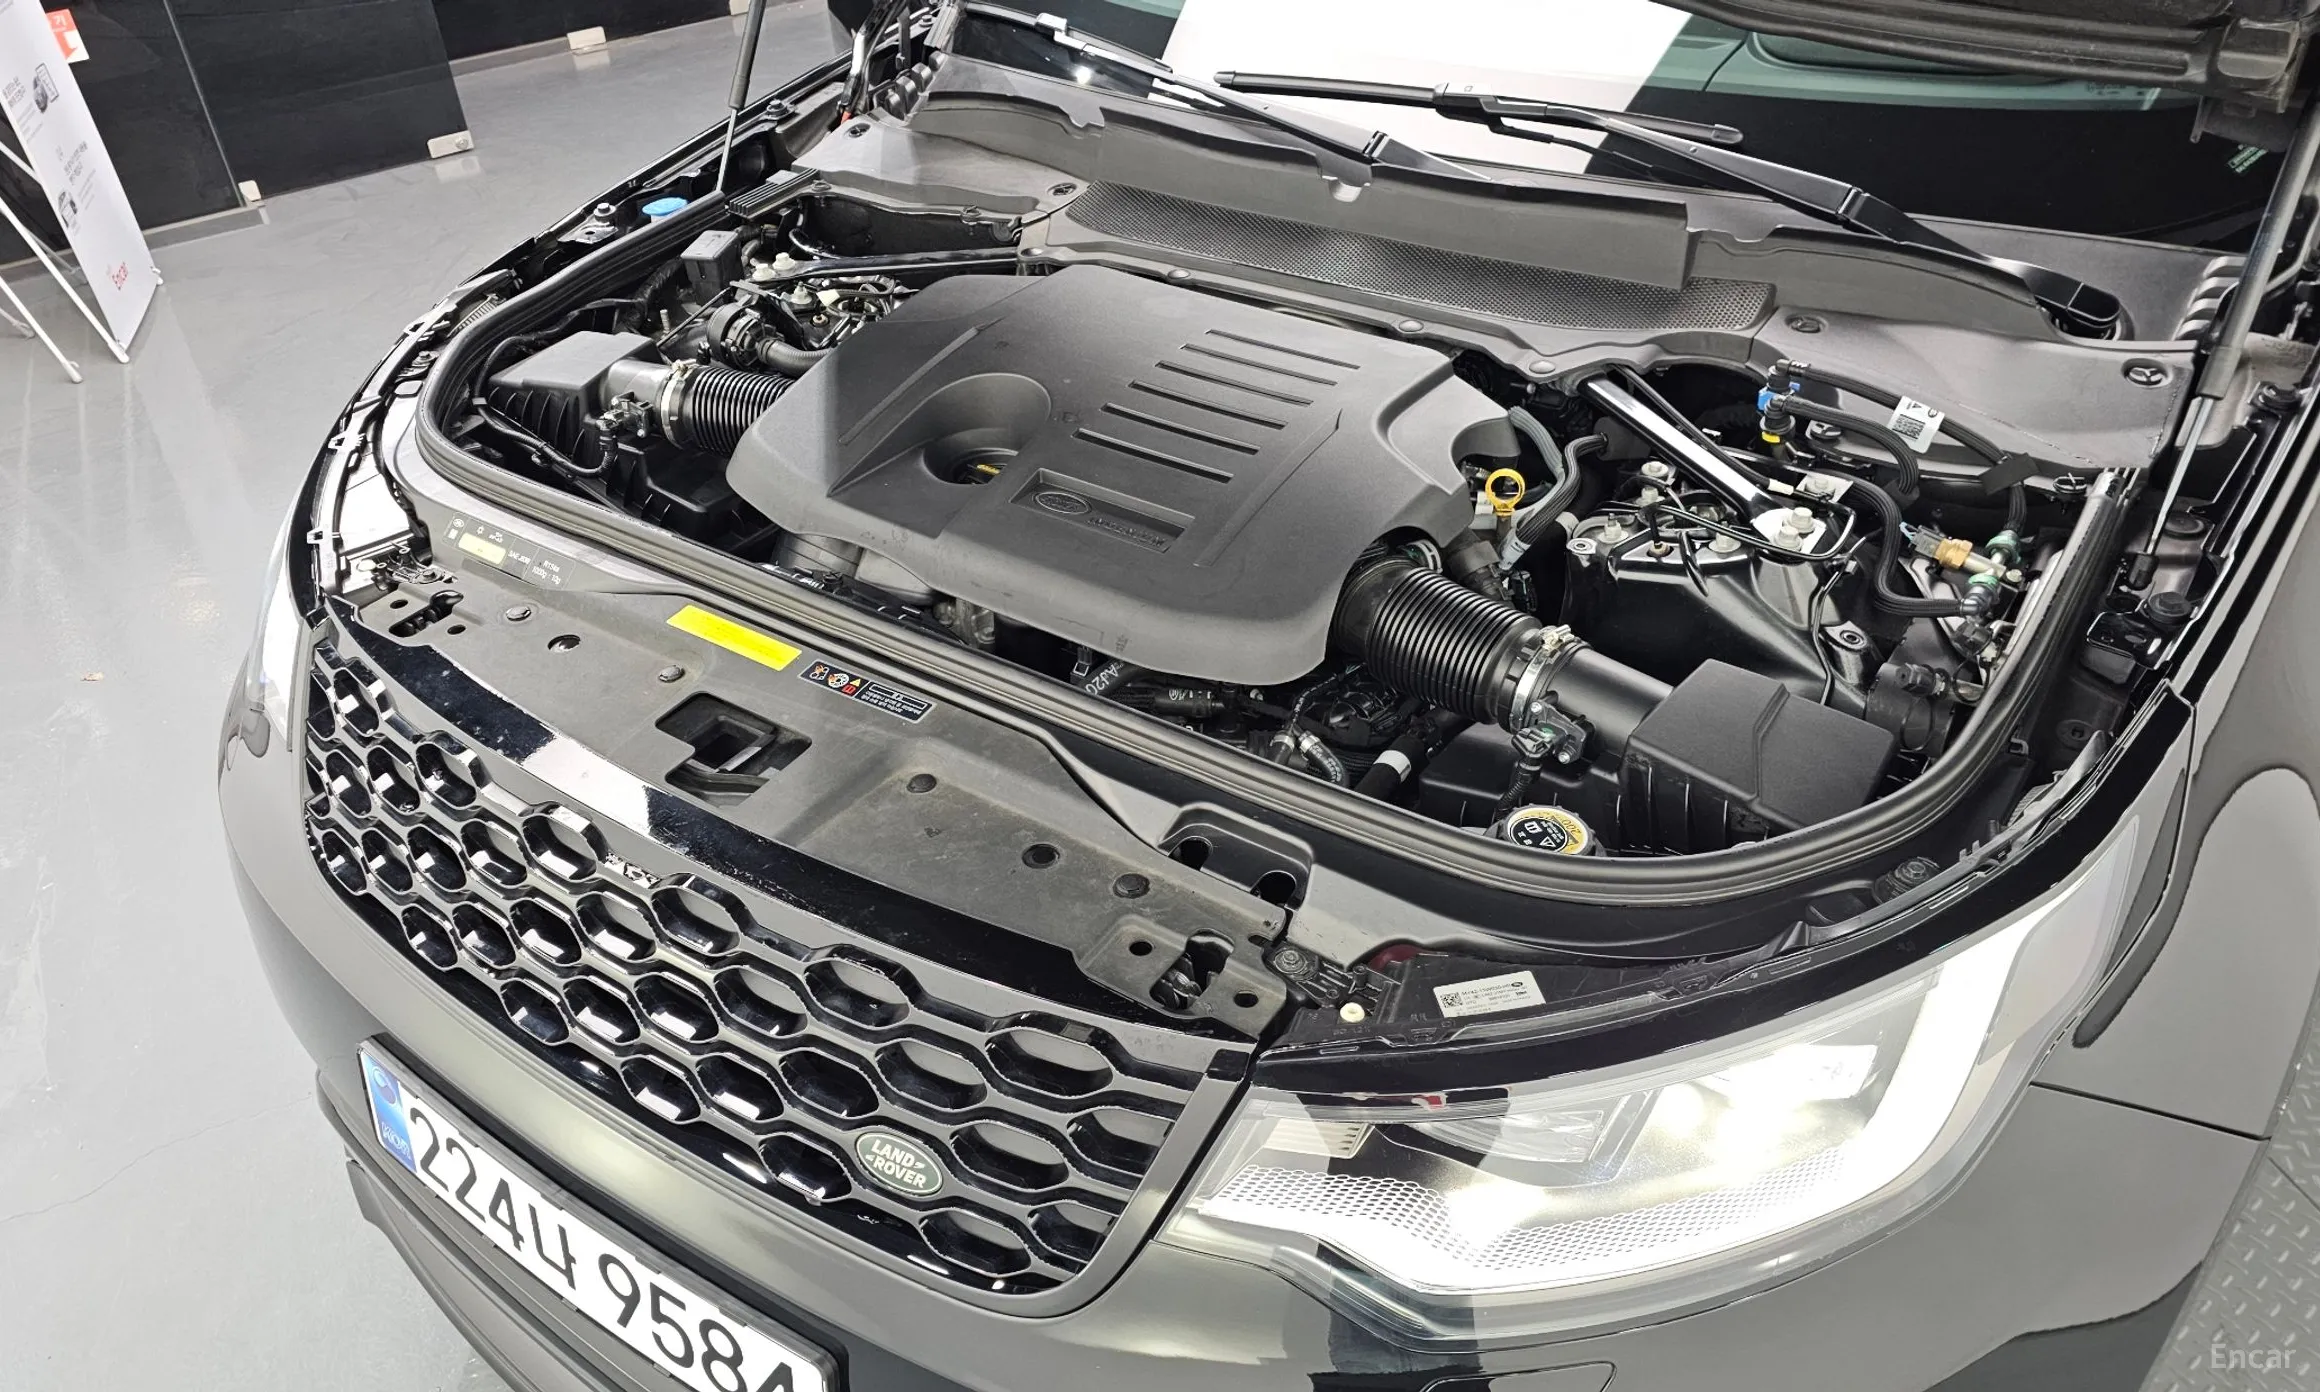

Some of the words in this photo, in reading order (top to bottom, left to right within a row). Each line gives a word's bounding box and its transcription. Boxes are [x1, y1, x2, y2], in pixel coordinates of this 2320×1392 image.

[871, 1139, 915, 1168] LAND
[873, 1155, 927, 1188] ROVER
[410, 1107, 577, 1291] 224나
